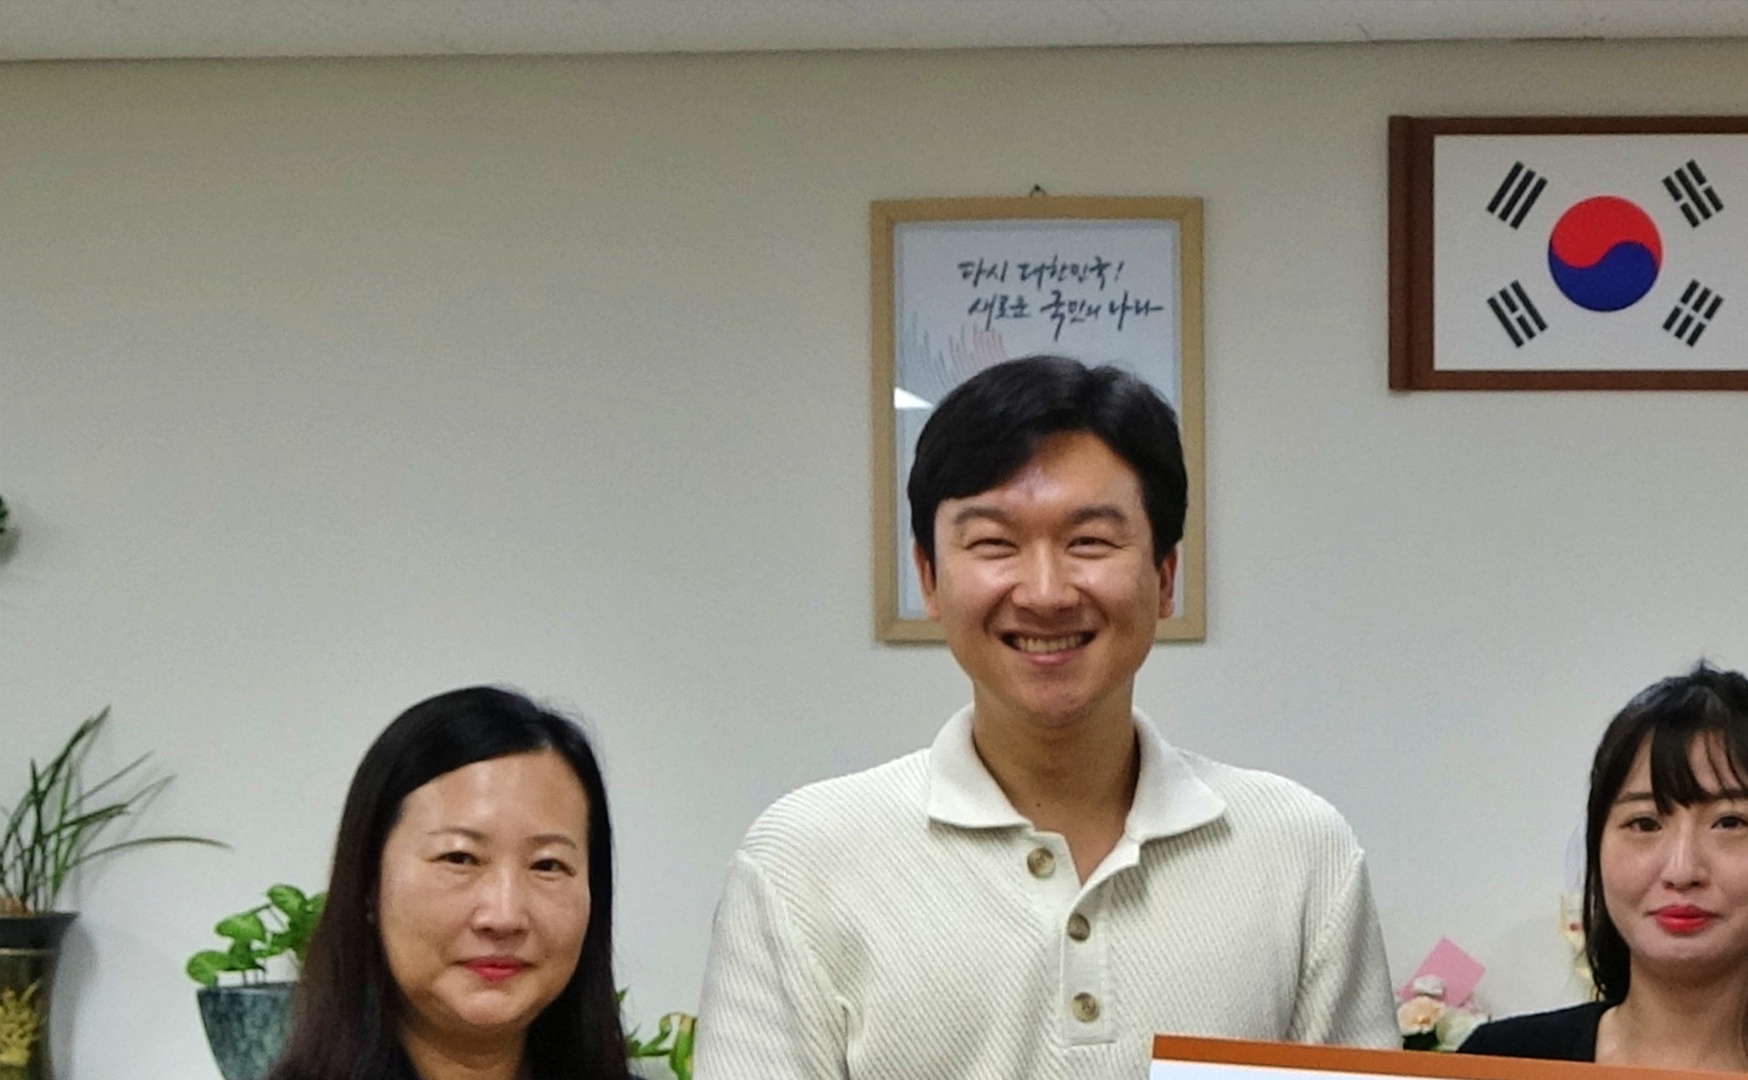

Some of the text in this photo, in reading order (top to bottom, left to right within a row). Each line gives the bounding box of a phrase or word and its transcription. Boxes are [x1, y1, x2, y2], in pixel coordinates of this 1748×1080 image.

[958, 254, 1125, 291] 다시 대한민국!
[968, 289, 1164, 342] 새로운 국민의 나라
